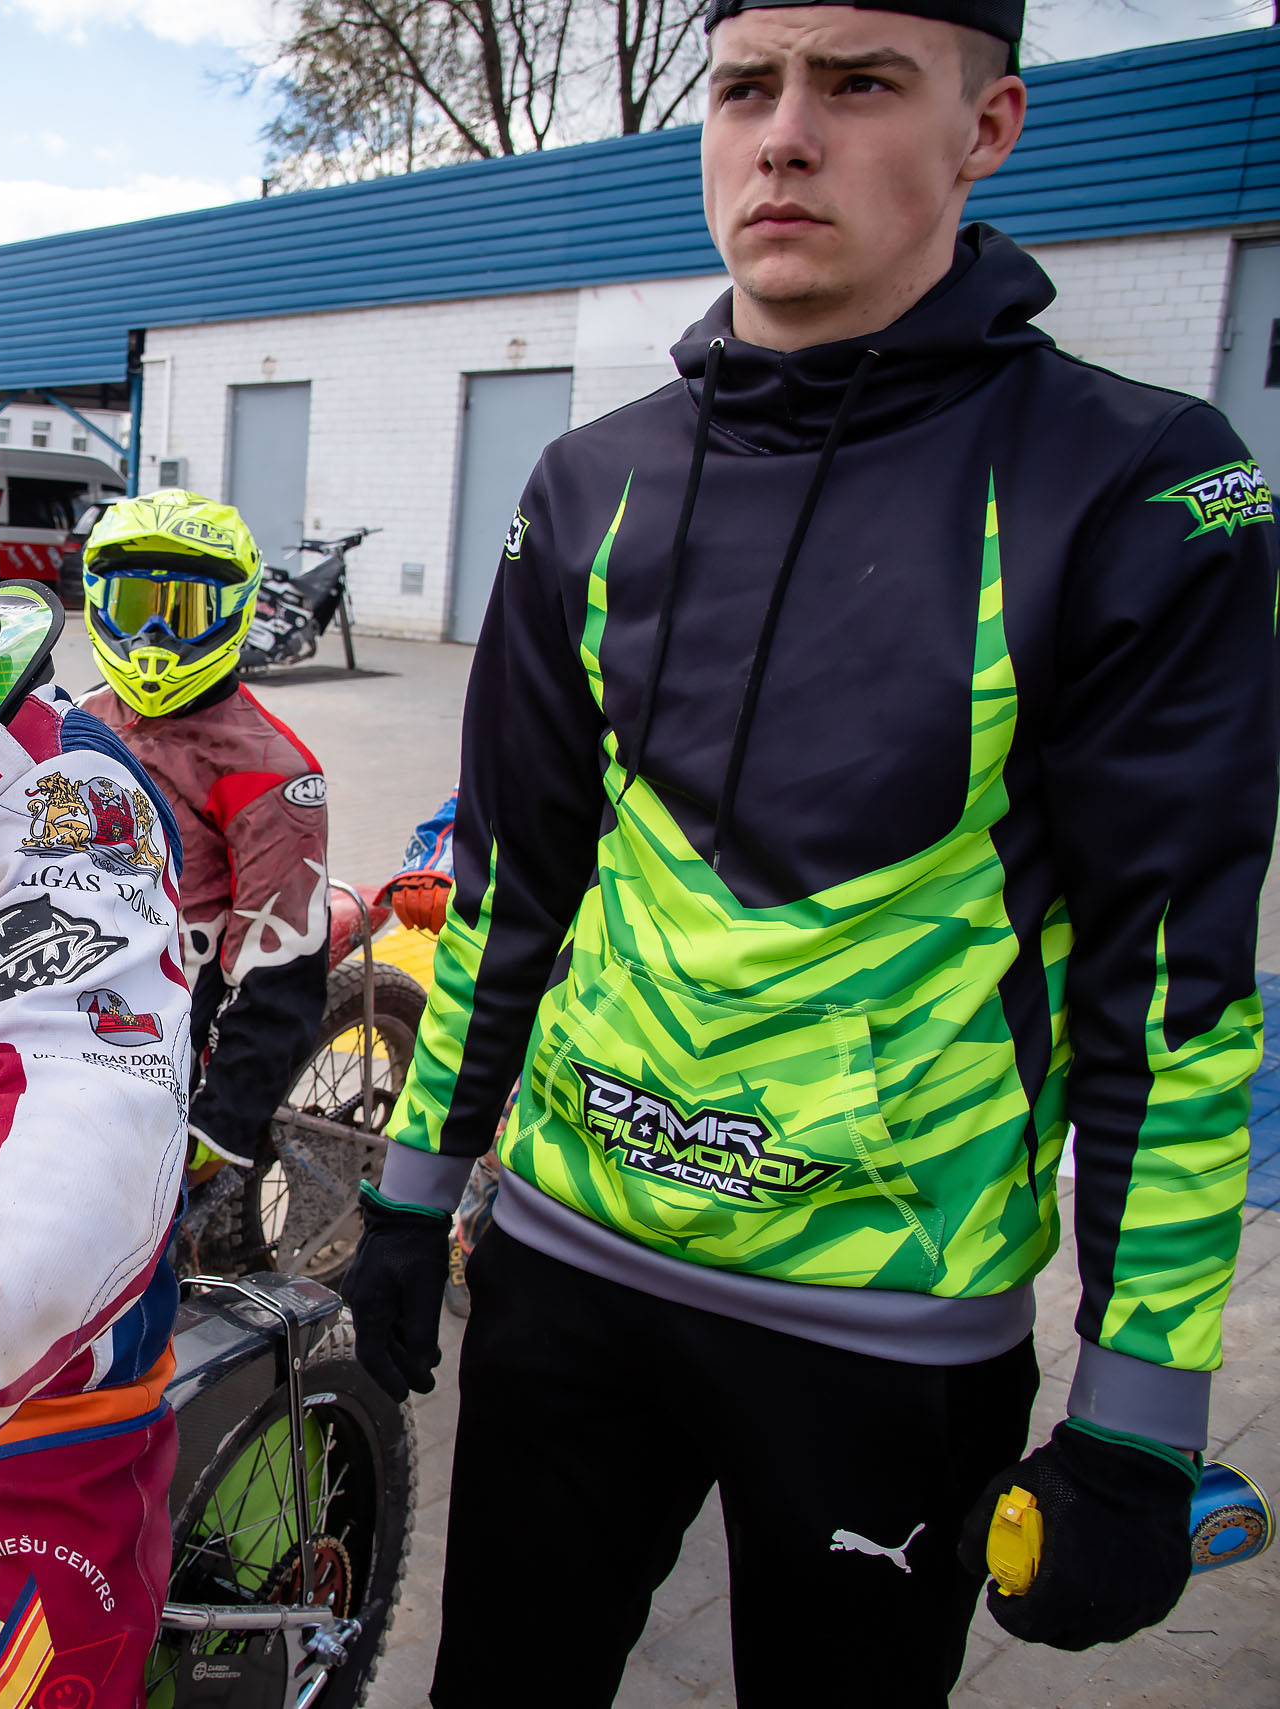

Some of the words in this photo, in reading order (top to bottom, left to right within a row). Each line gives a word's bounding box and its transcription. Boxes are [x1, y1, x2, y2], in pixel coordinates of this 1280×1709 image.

[586, 1073, 763, 1157] DAMIR
[629, 1149, 750, 1197] RACING
[54, 1545, 115, 1613] CENTRS
